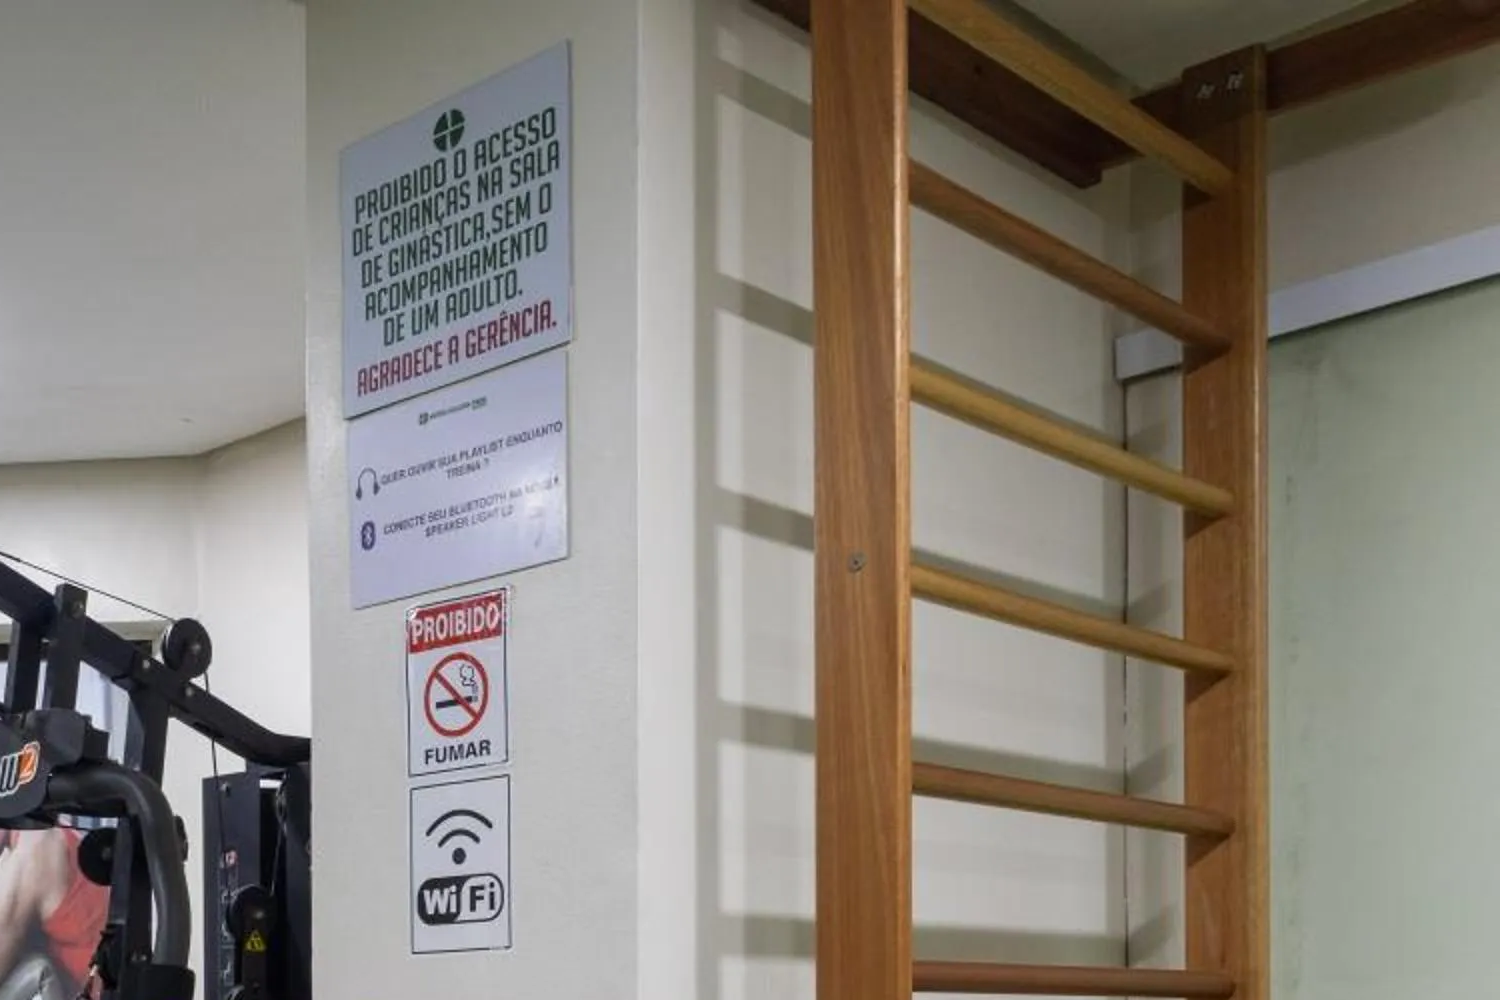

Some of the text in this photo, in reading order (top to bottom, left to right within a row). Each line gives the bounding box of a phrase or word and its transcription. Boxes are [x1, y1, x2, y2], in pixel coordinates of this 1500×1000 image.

[353, 140, 560, 256] DE CRIANÇAS NA SALA
[355, 106, 556, 224] PROIBIDO O ACESSO
[362, 254, 383, 288] DE
[539, 181, 552, 213] O
[366, 221, 548, 321] ACOMPANHAMENTO
[357, 299, 557, 397] AGRADECE A GERÊNCIA.
[384, 268, 523, 347] DE UM ADULTO.
[381, 468, 406, 485] QUER
[460, 438, 503, 460] PLAYLIST
[506, 420, 563, 447] ENQUANTO
[383, 513, 425, 535] CONECTE
[428, 507, 447, 523] SEU
[412, 600, 500, 645] PROIBIDO
[424, 740, 491, 765] FUMAR
